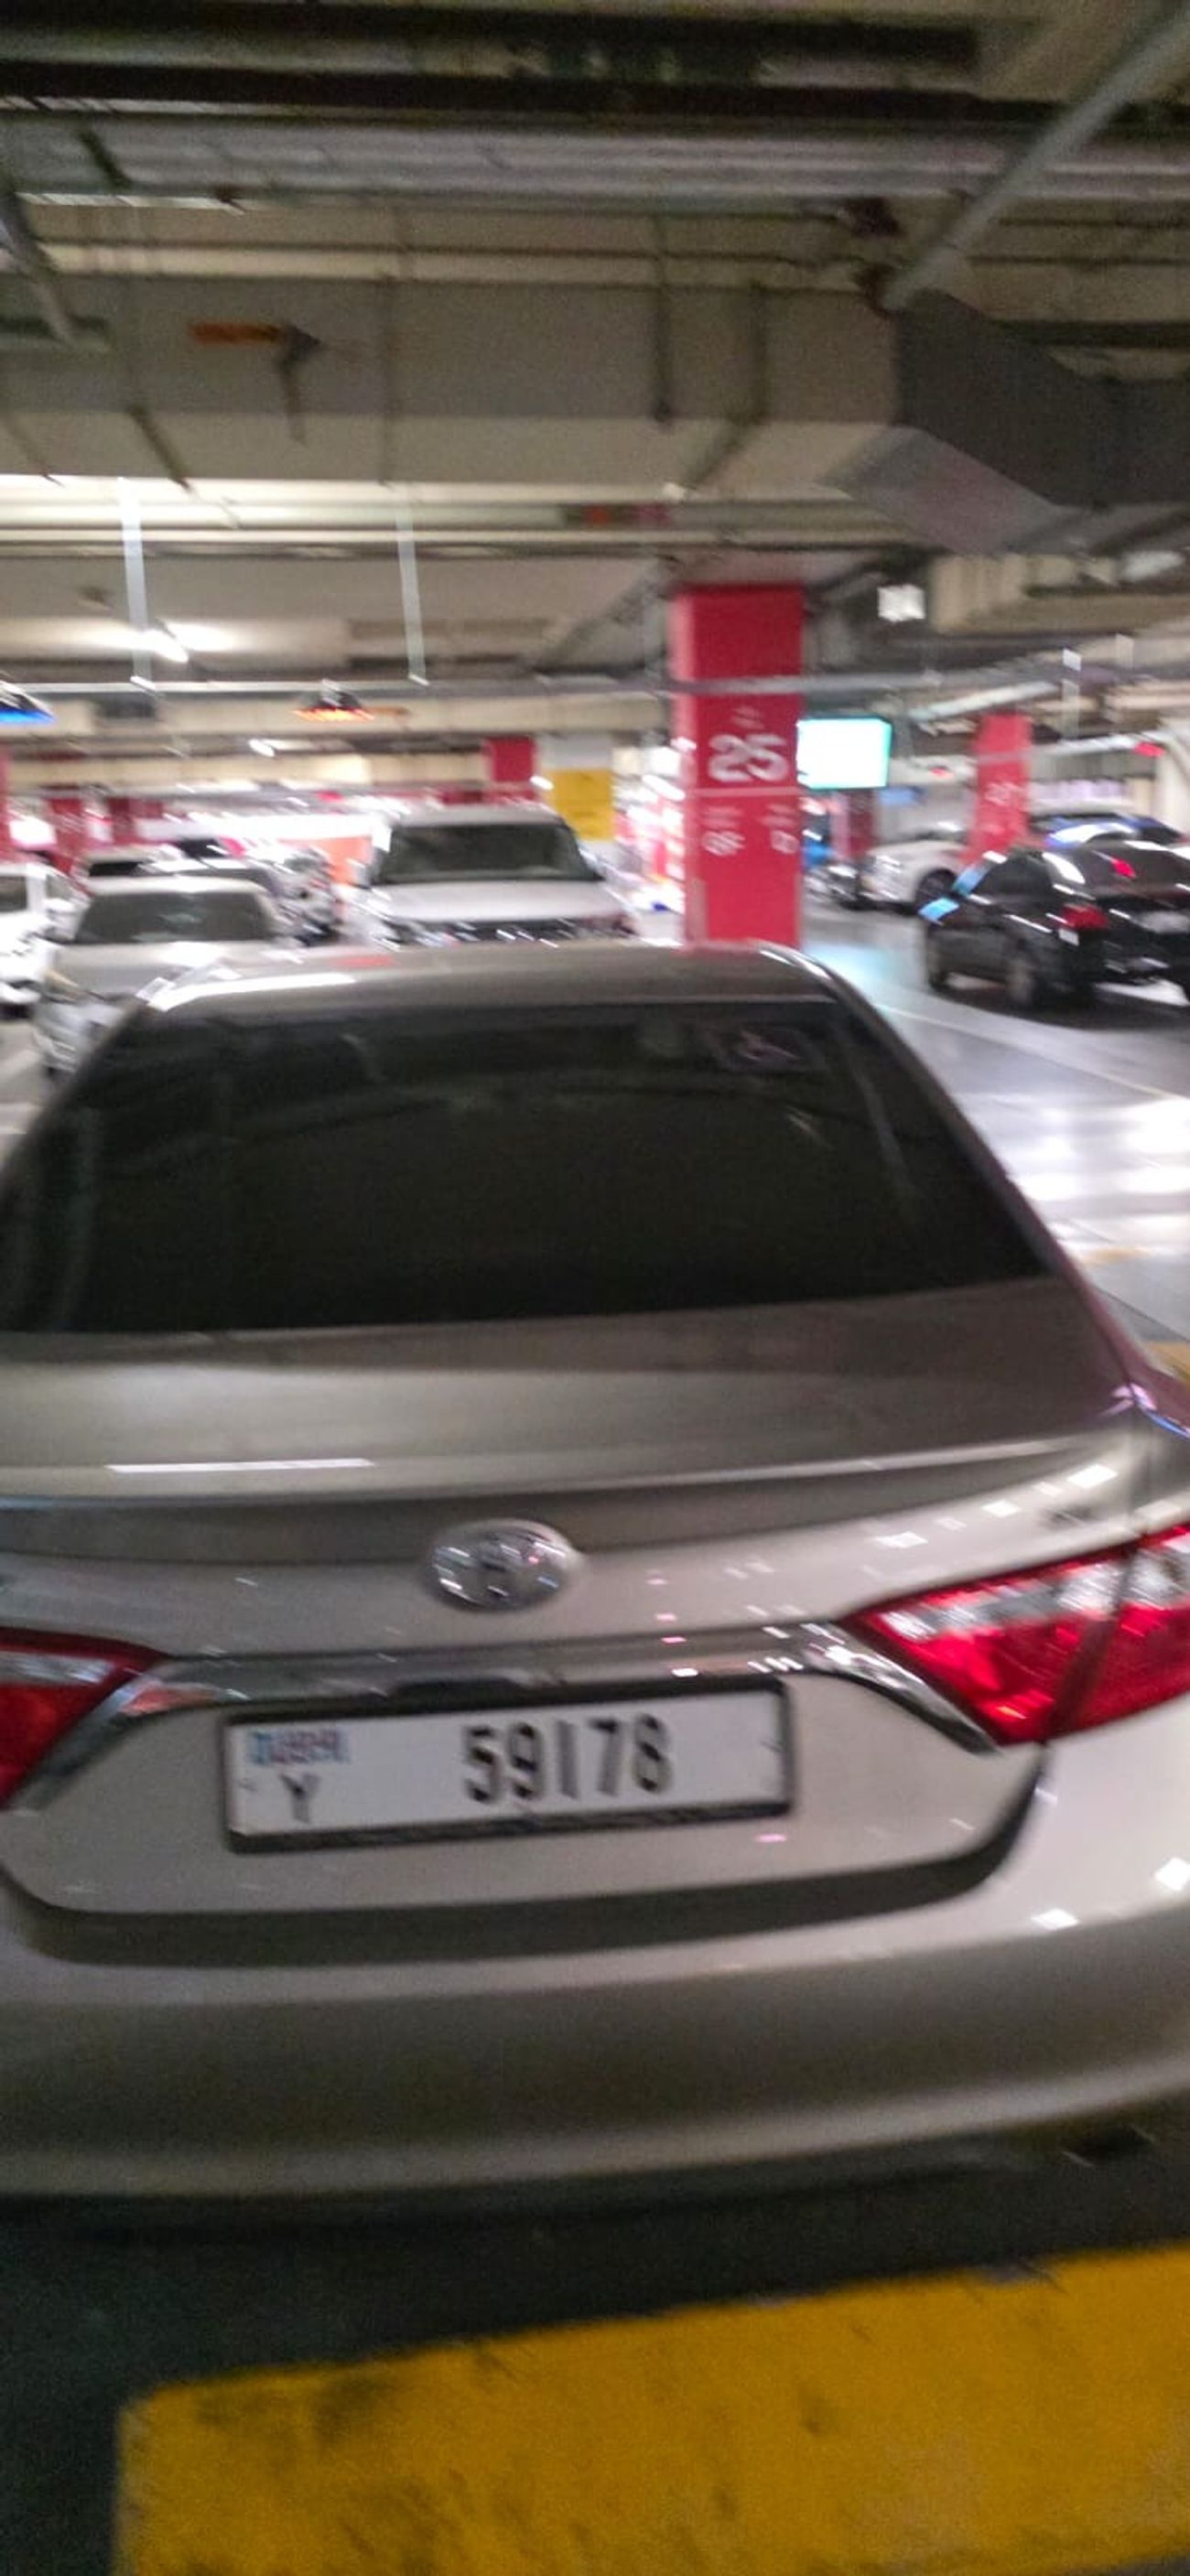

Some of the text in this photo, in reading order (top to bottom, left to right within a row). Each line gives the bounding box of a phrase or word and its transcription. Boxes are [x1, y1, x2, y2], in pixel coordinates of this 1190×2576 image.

[709, 734, 789, 782] 25
[461, 1712, 674, 1803] 59178
[278, 1773, 320, 1820] Y
